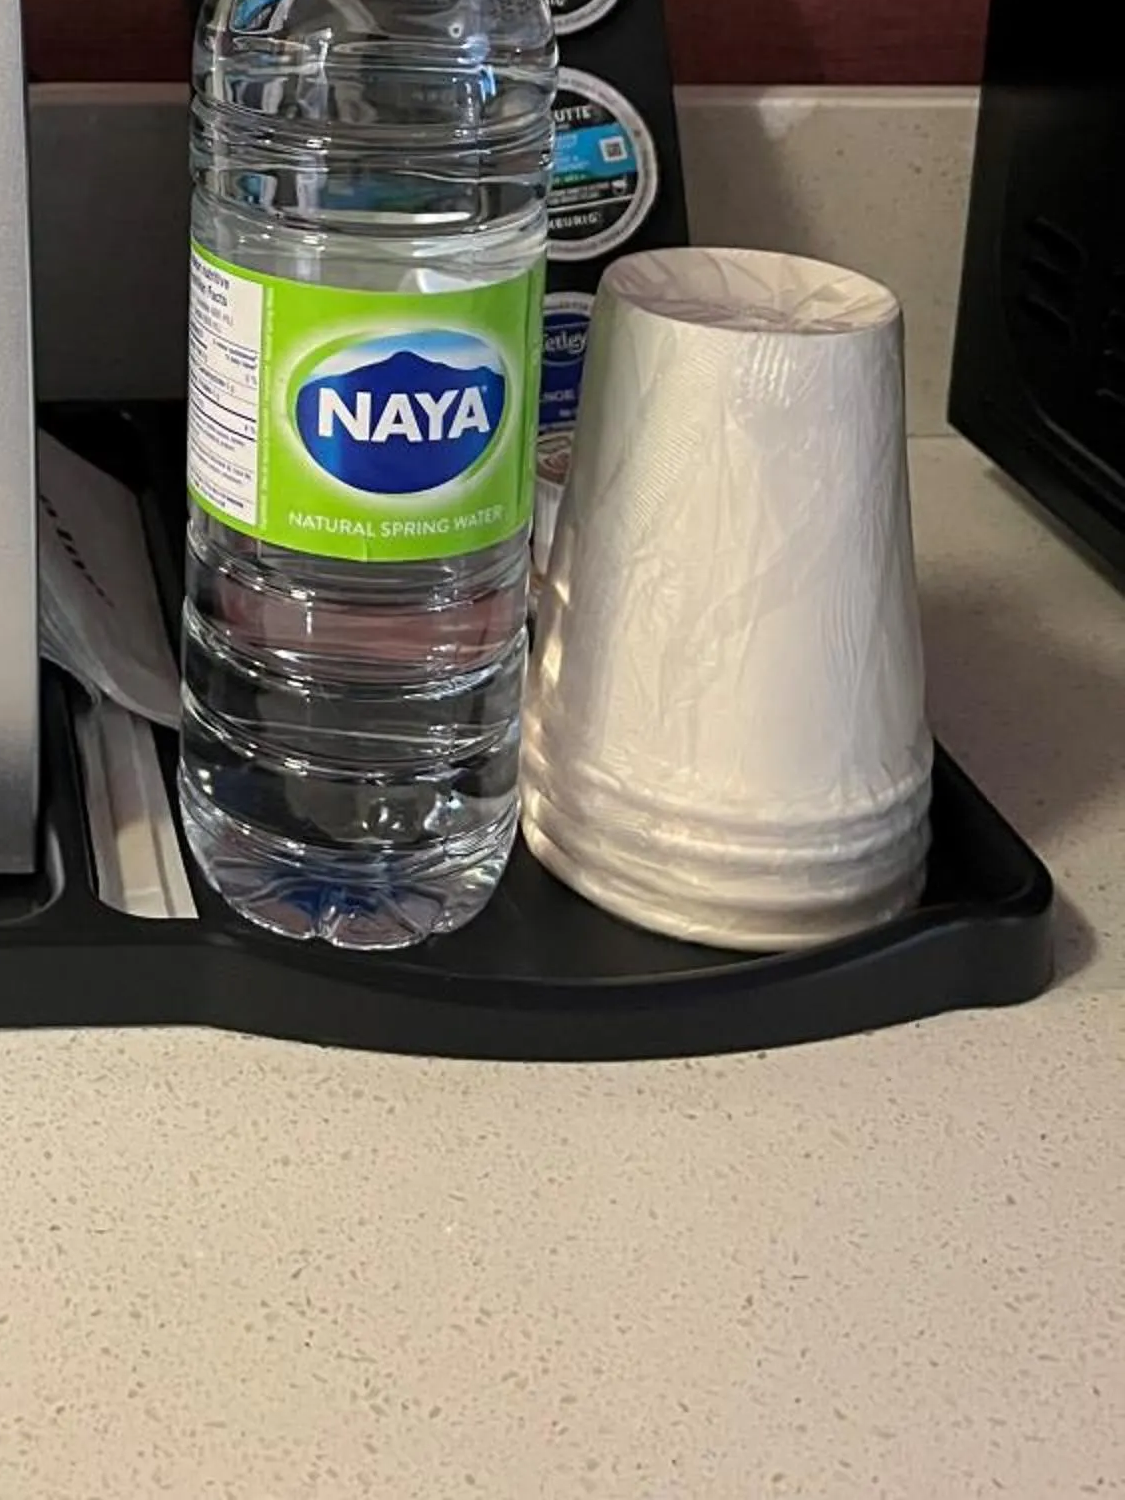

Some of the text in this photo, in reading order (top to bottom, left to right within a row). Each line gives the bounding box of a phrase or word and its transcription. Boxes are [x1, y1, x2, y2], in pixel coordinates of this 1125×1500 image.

[542, 329, 587, 355] etley
[317, 386, 492, 444] NAYA
[287, 504, 505, 539] NATURAL SPRING WATER
